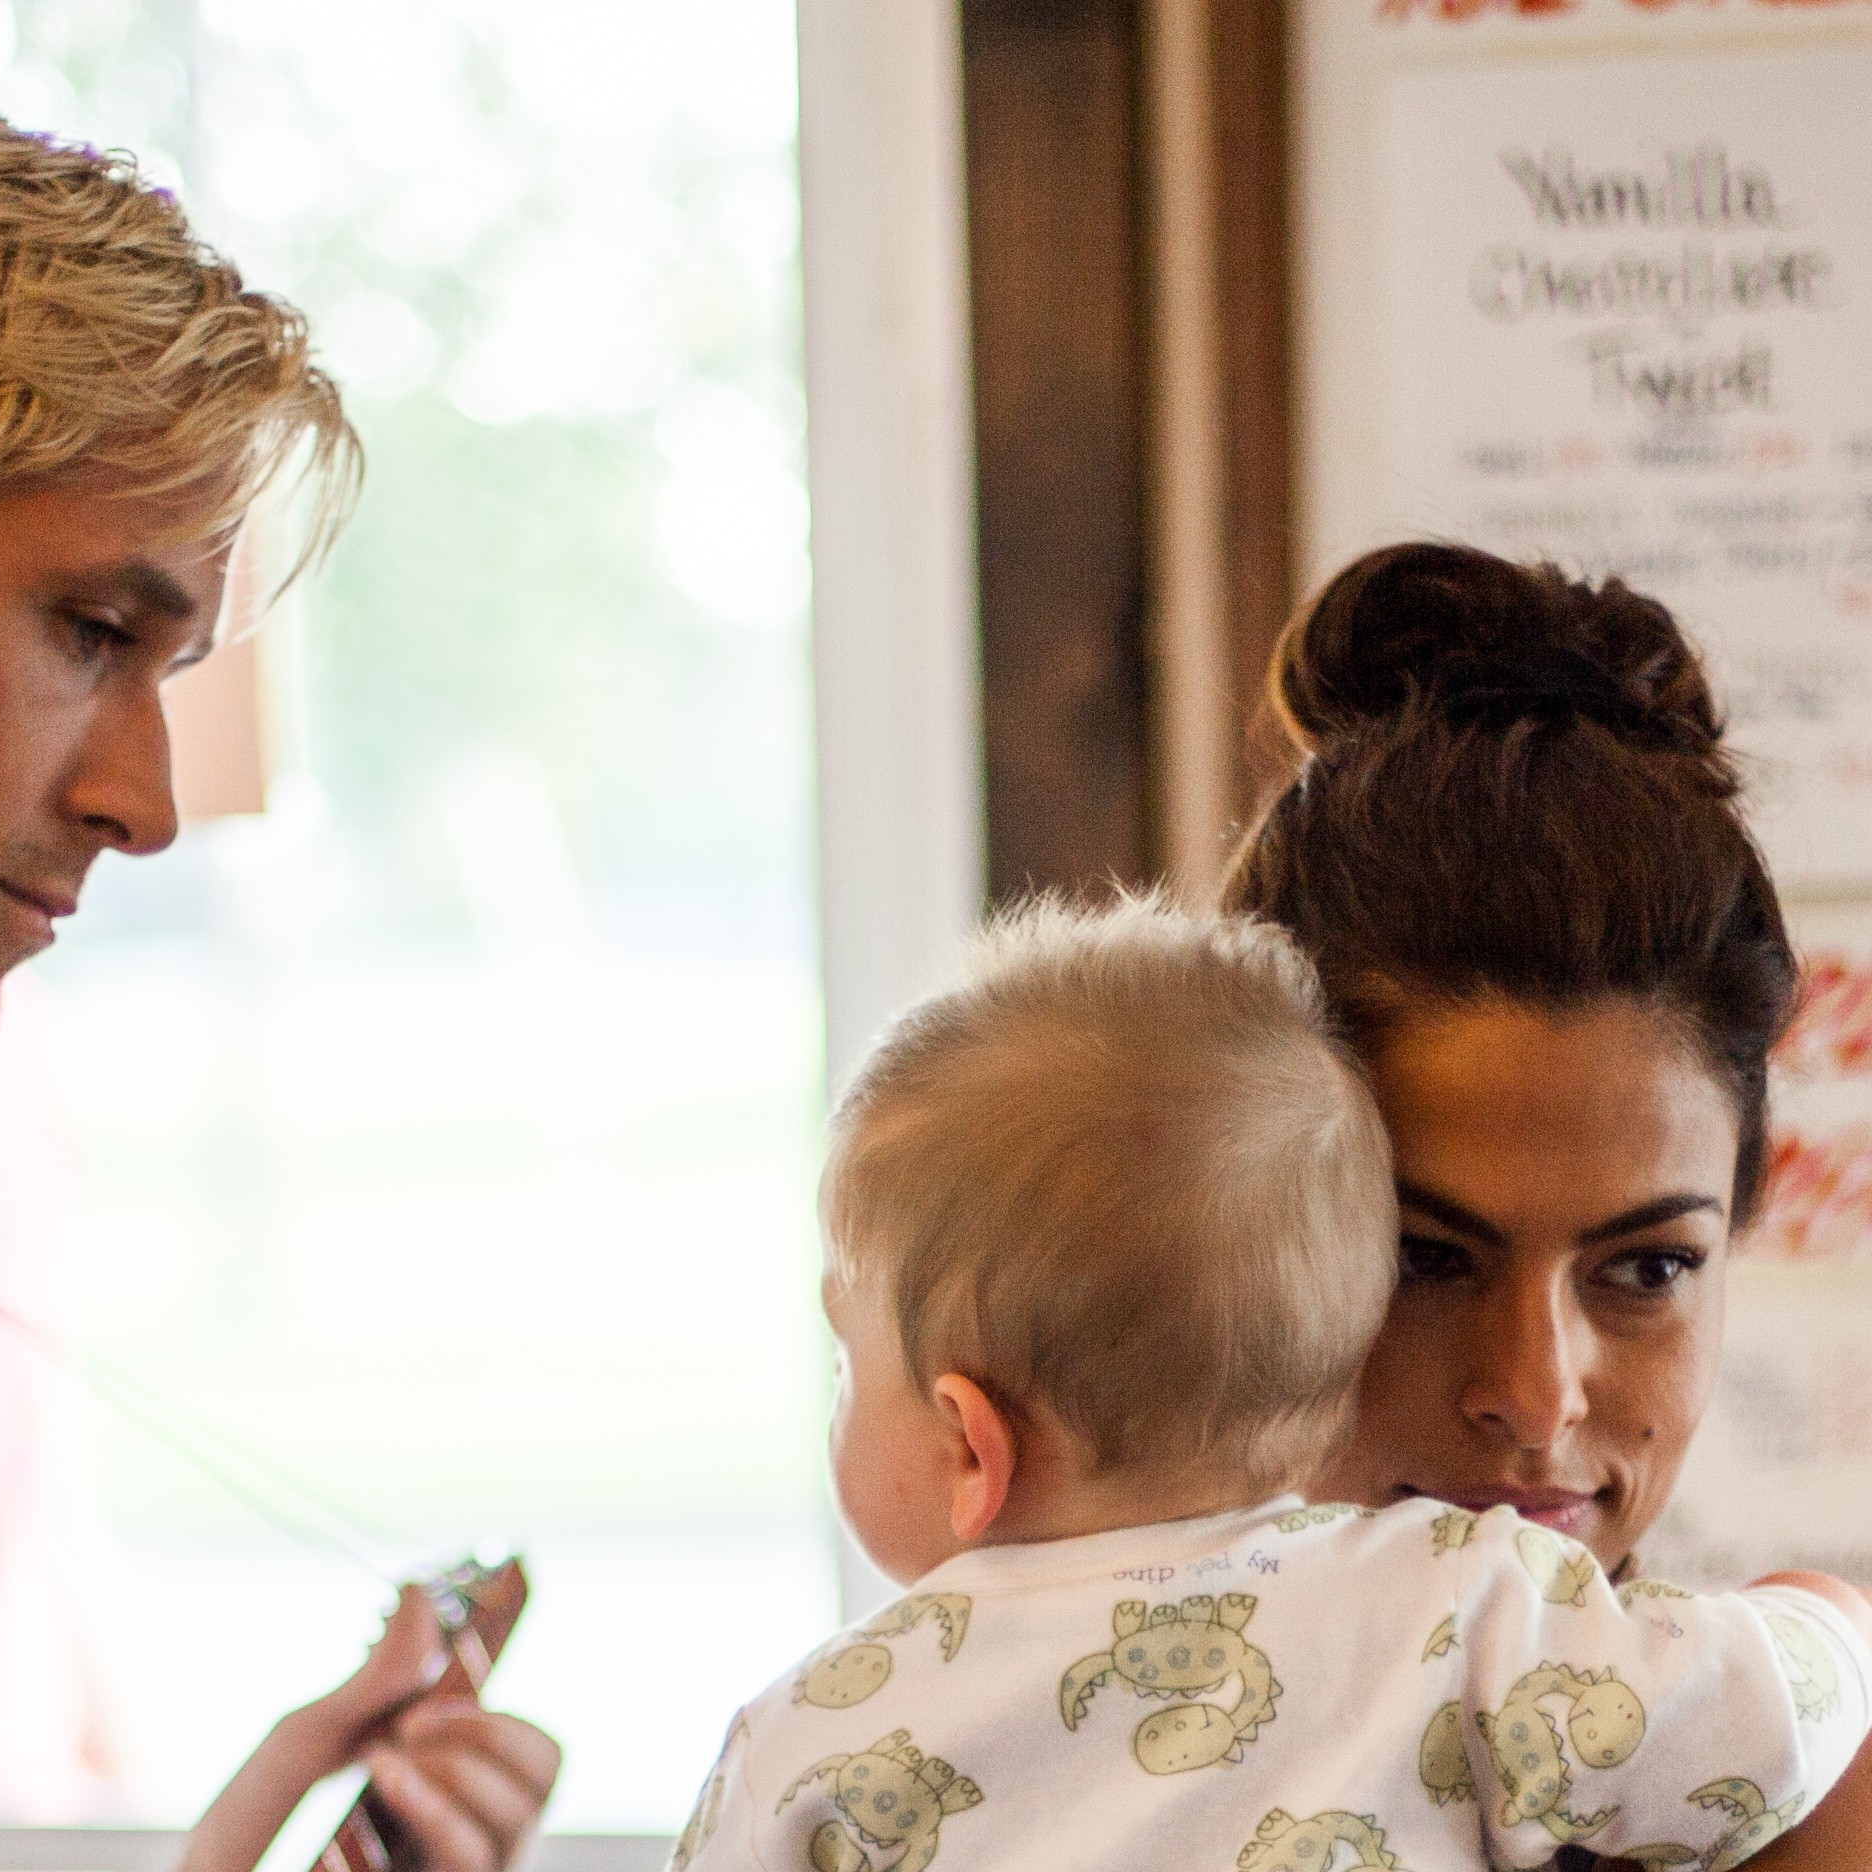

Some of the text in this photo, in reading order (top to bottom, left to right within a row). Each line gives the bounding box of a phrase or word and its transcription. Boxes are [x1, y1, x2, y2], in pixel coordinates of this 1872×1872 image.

[1502, 141, 1782, 229] Vanilla
[1111, 1549, 1281, 1585] My pet dino
